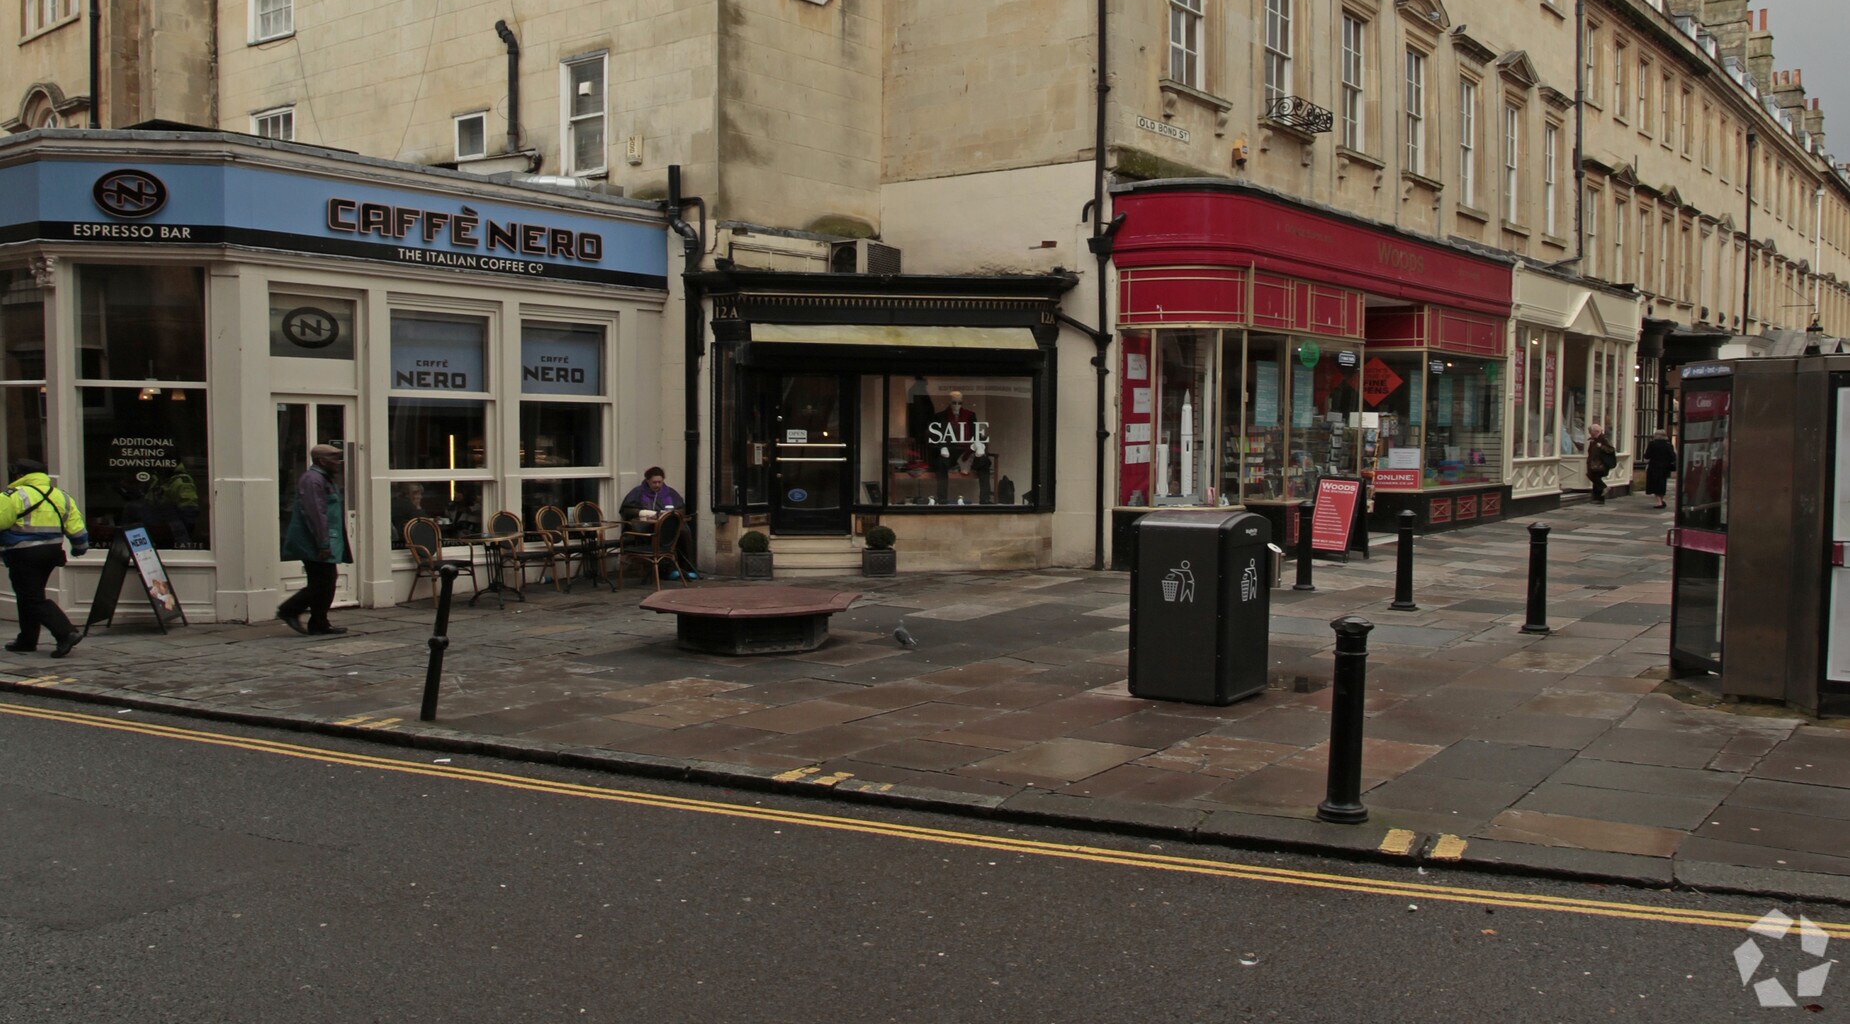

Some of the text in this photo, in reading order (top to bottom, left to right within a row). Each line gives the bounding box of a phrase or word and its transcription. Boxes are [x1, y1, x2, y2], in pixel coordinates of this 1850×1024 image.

[1139, 118, 1156, 130] OLD
[1158, 123, 1178, 137] BOND
[73, 223, 191, 239] ESPRESSO BAR
[485, 217, 604, 262] NERO
[397, 248, 422, 262] THE
[426, 251, 477, 268] ITALIAN
[480, 257, 525, 274] COFFEE
[396, 370, 467, 389] NERO
[523, 365, 585, 384] NERO
[111, 437, 174, 447] ADDITIONAL
[928, 421, 990, 444] SALE
[121, 447, 165, 457] SEATING
[109, 458, 177, 468] DOWNSTAIRS
[131, 537, 148, 547] NERO
